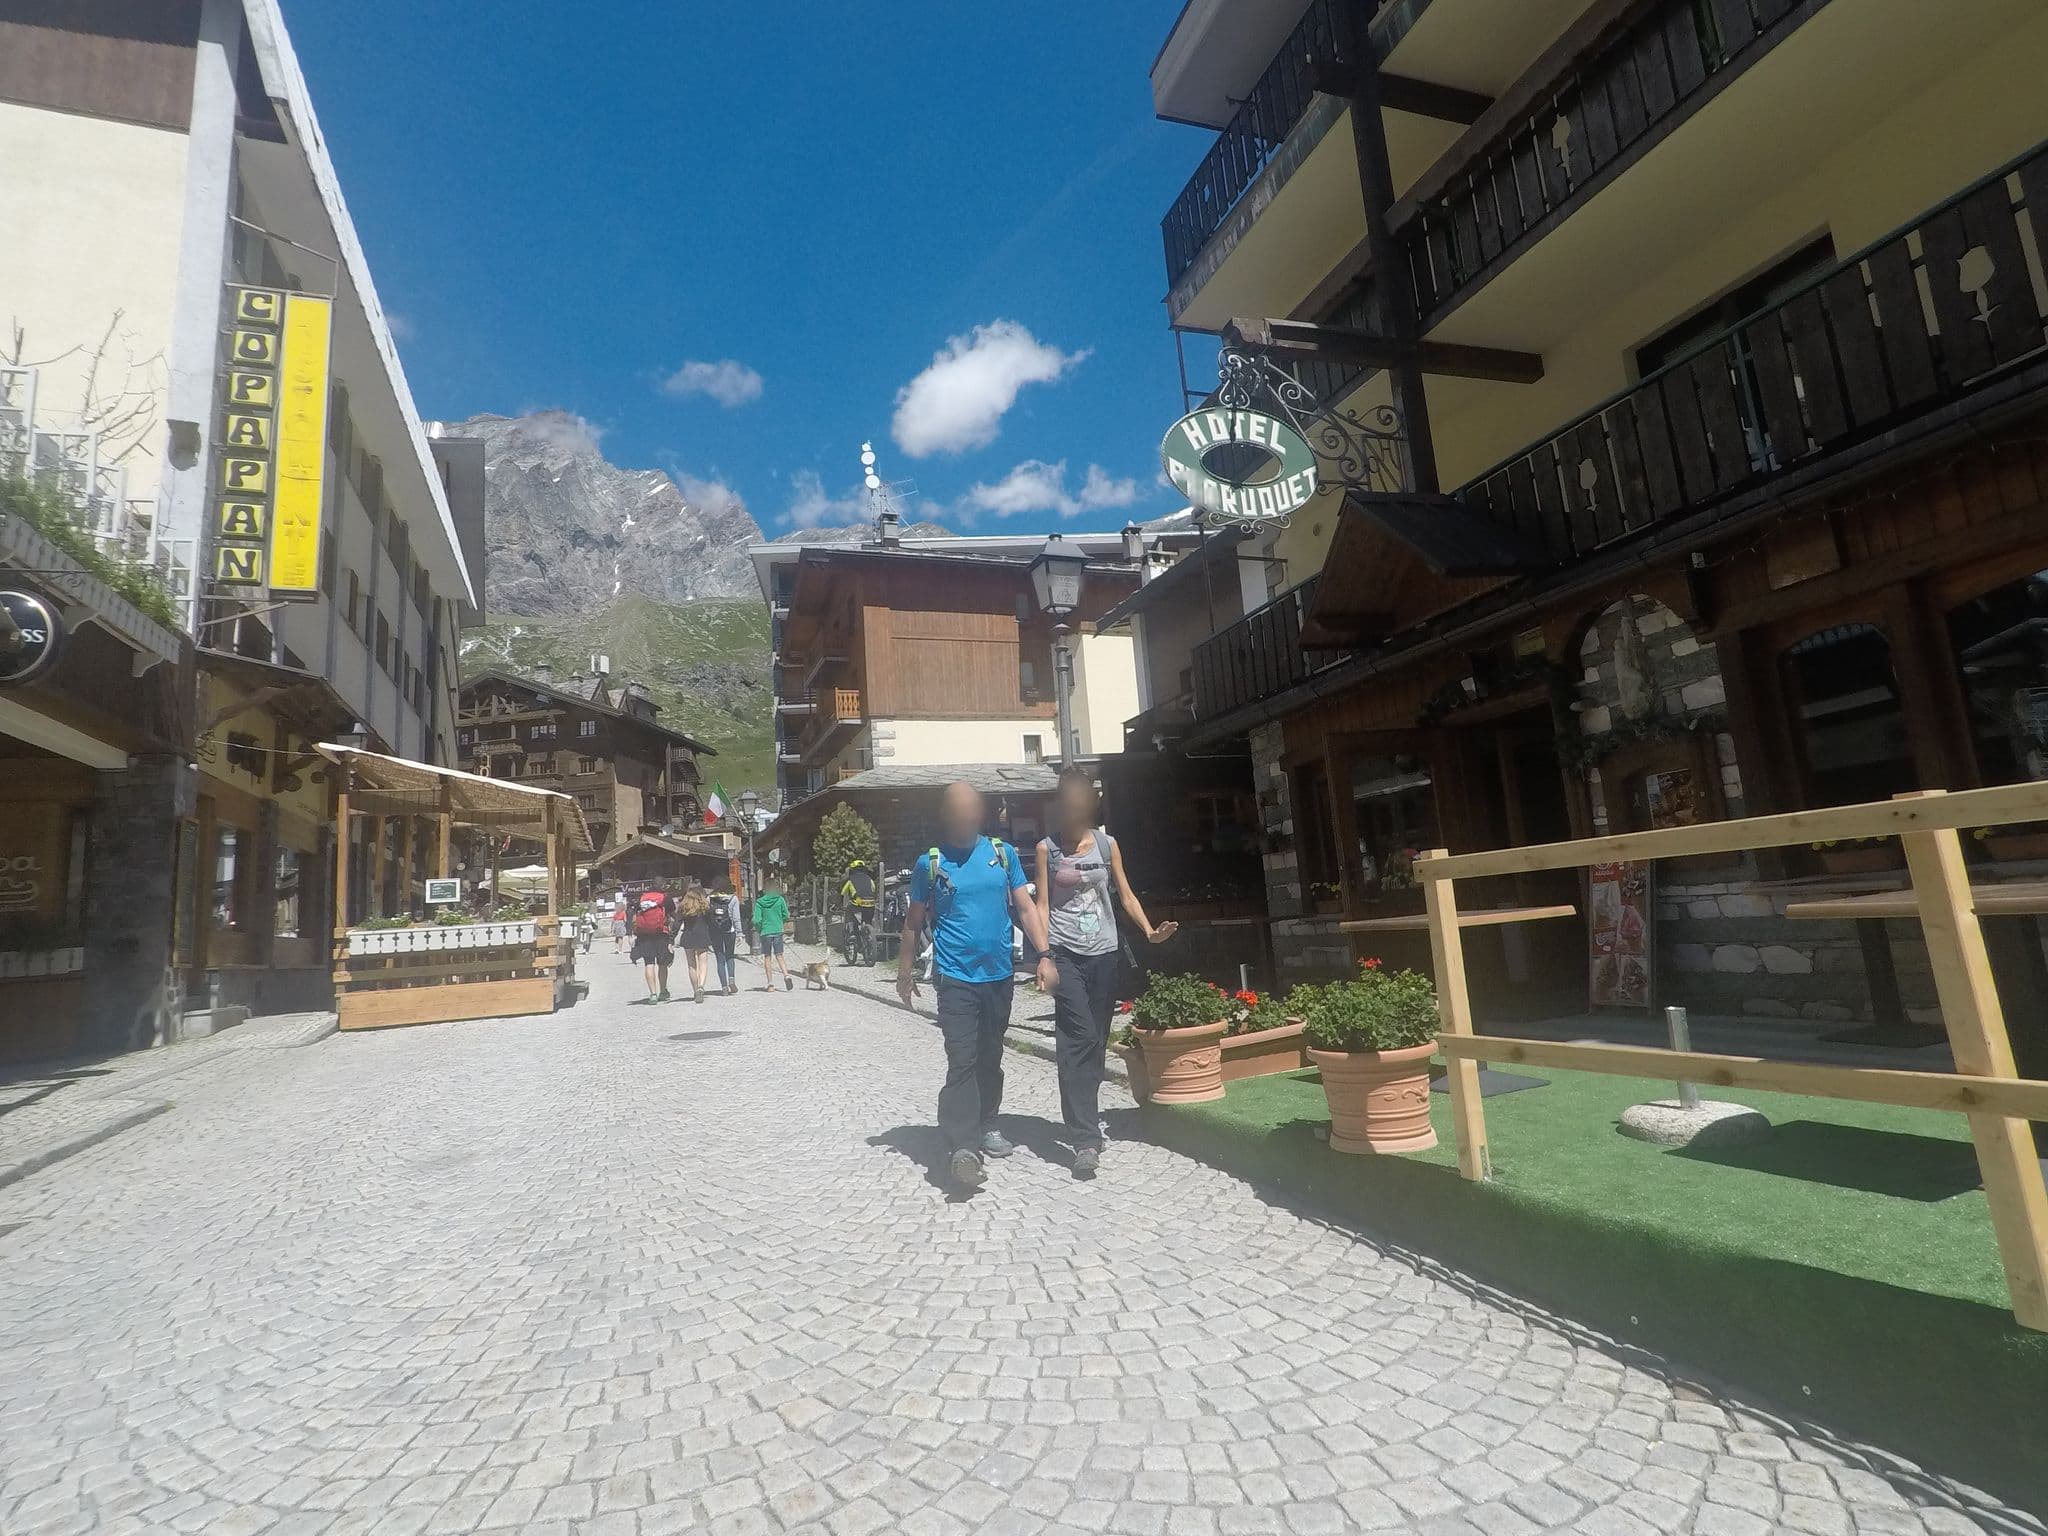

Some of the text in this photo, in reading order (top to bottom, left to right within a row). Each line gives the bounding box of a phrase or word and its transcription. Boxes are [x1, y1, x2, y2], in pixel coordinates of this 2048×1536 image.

[219, 290, 273, 578] COPAPAN
[1181, 411, 1287, 455] HOTEL
[1168, 456, 1317, 517] PRUQUET
